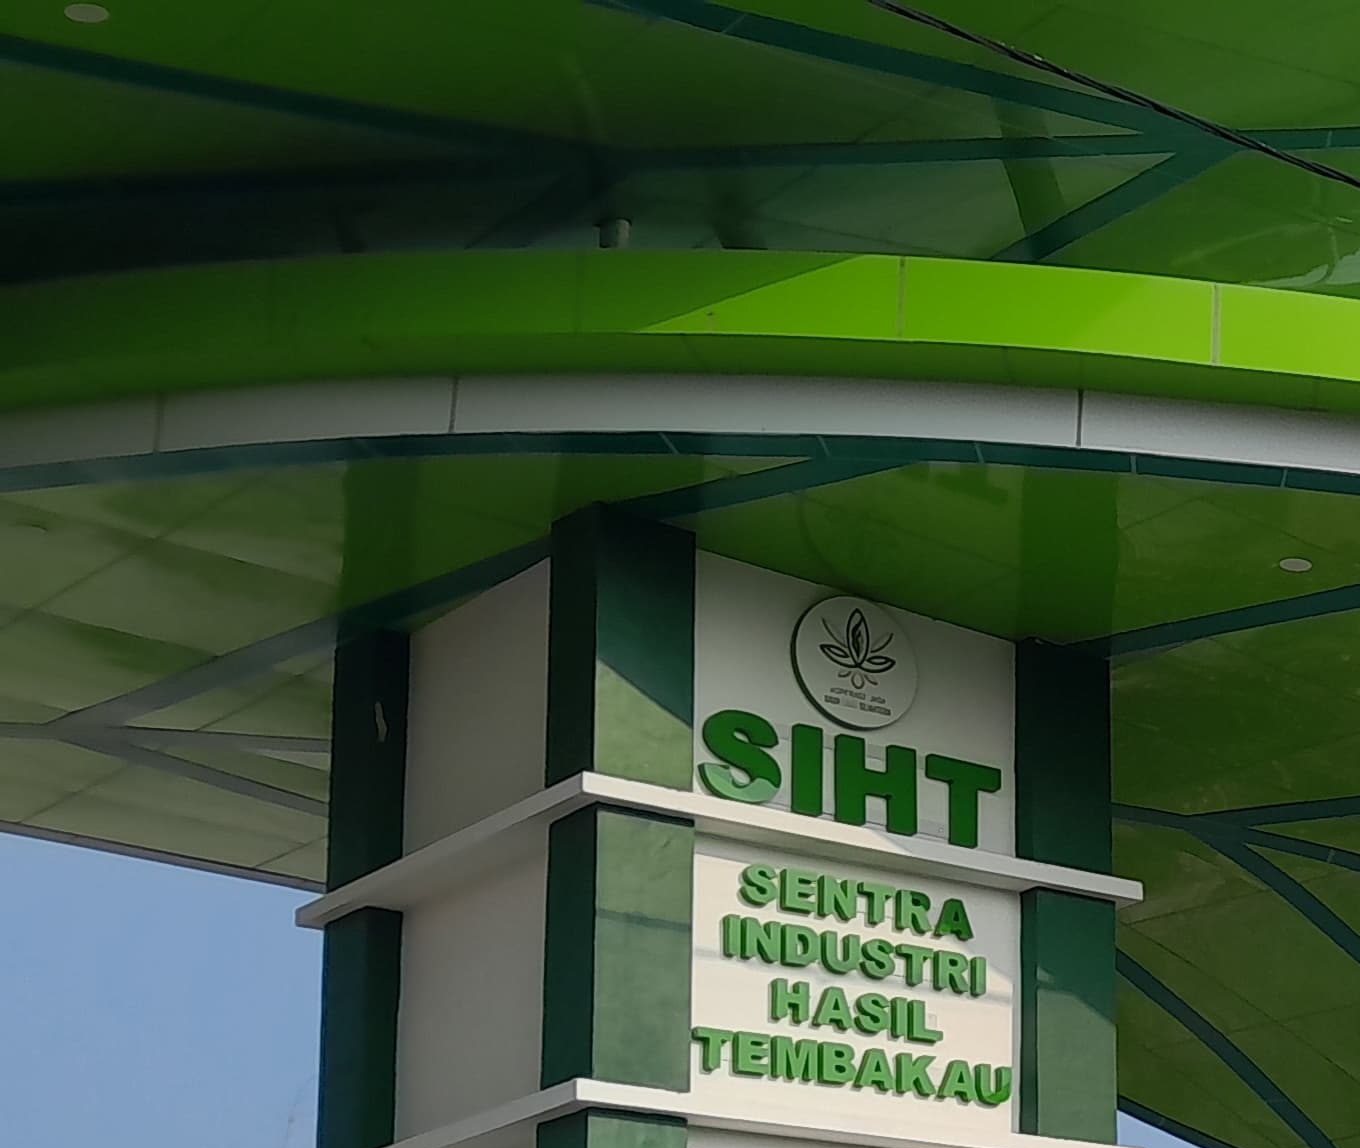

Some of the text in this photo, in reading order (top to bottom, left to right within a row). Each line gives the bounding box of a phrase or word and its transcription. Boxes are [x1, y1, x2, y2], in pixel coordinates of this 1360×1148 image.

[697, 708, 1003, 849] SIHT
[738, 863, 975, 941] SENTRA
[721, 914, 988, 997] INDUSTRI
[768, 977, 944, 1044] HASIL
[691, 1026, 1013, 1106] TEMBAKAU
